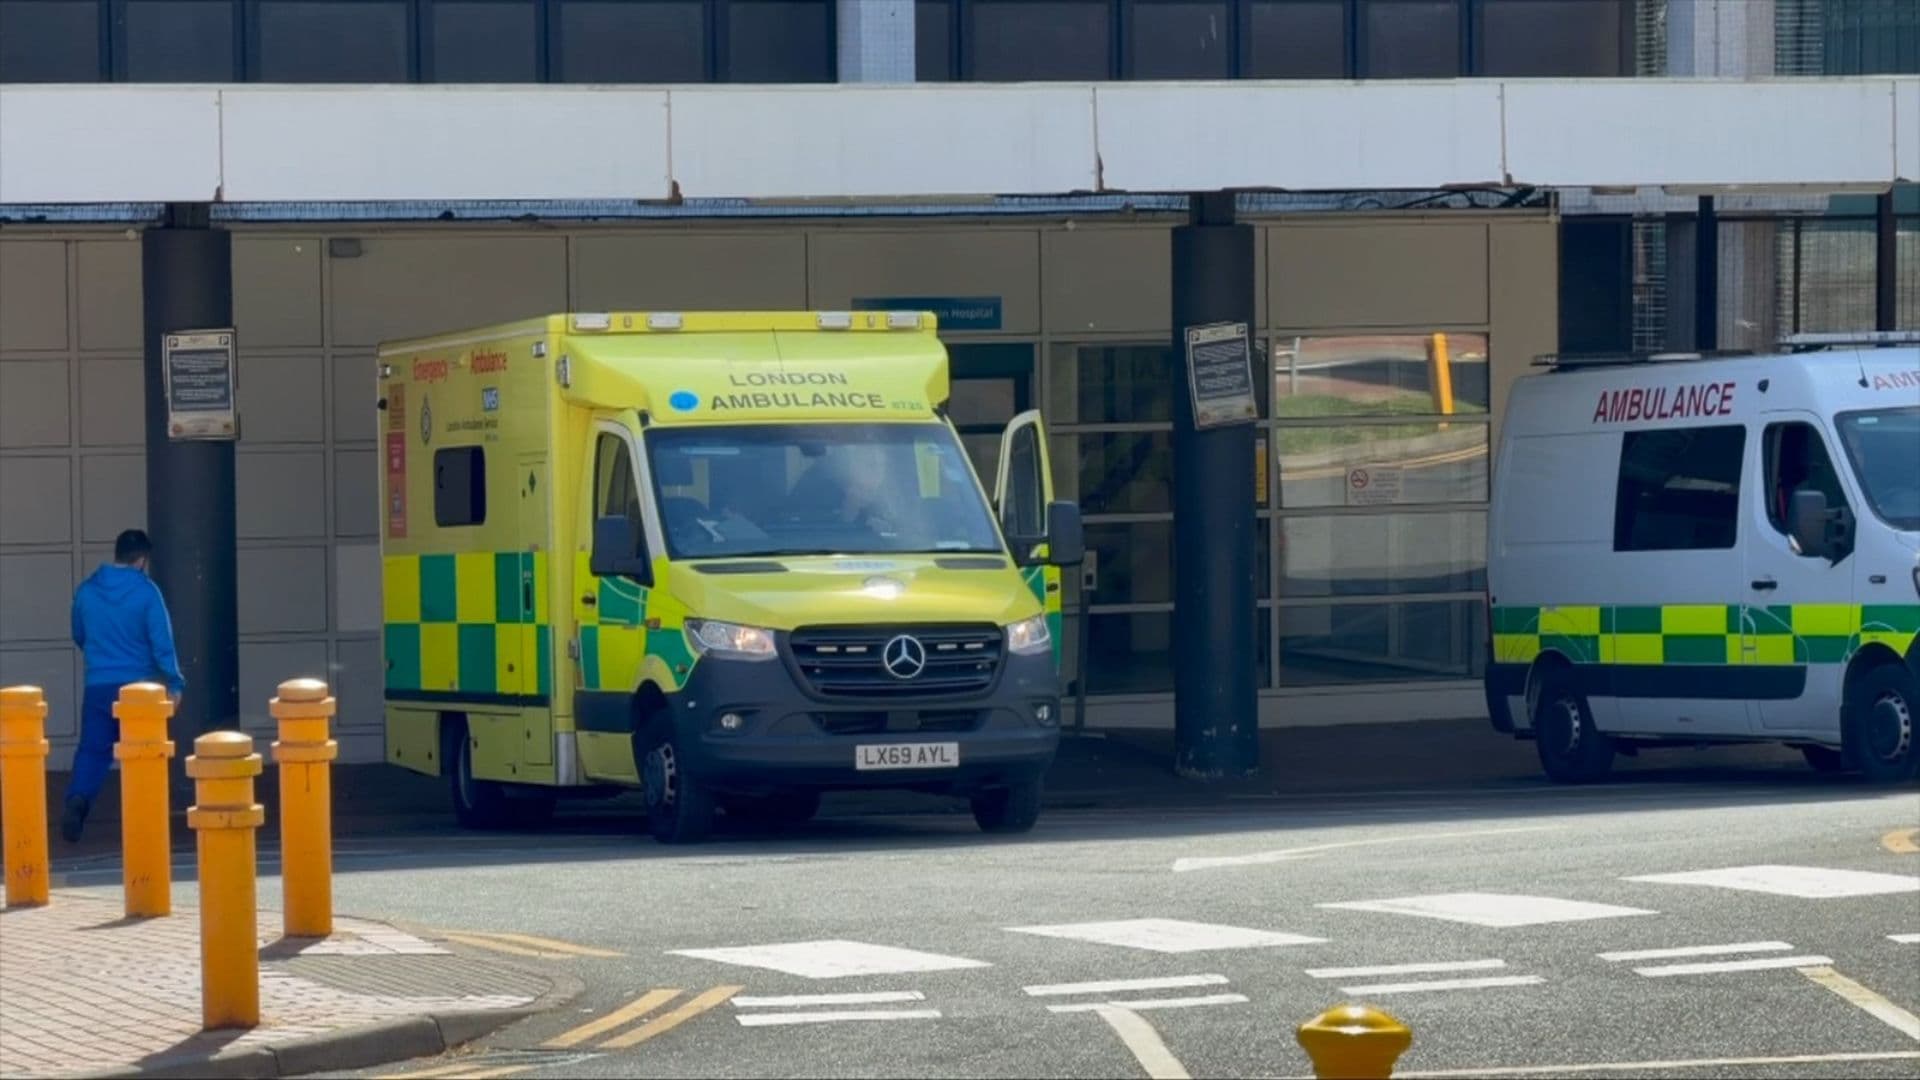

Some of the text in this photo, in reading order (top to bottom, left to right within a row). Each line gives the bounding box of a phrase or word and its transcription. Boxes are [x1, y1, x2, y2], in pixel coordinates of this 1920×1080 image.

[952, 308, 993, 320] Hospital
[412, 350, 507, 383] Emergency Ambulance
[728, 372, 848, 387] LONDON
[711, 392, 886, 410] AMBULANCE
[1592, 382, 1736, 424] AMBULANCE
[864, 745, 952, 765] LX69 AYL
